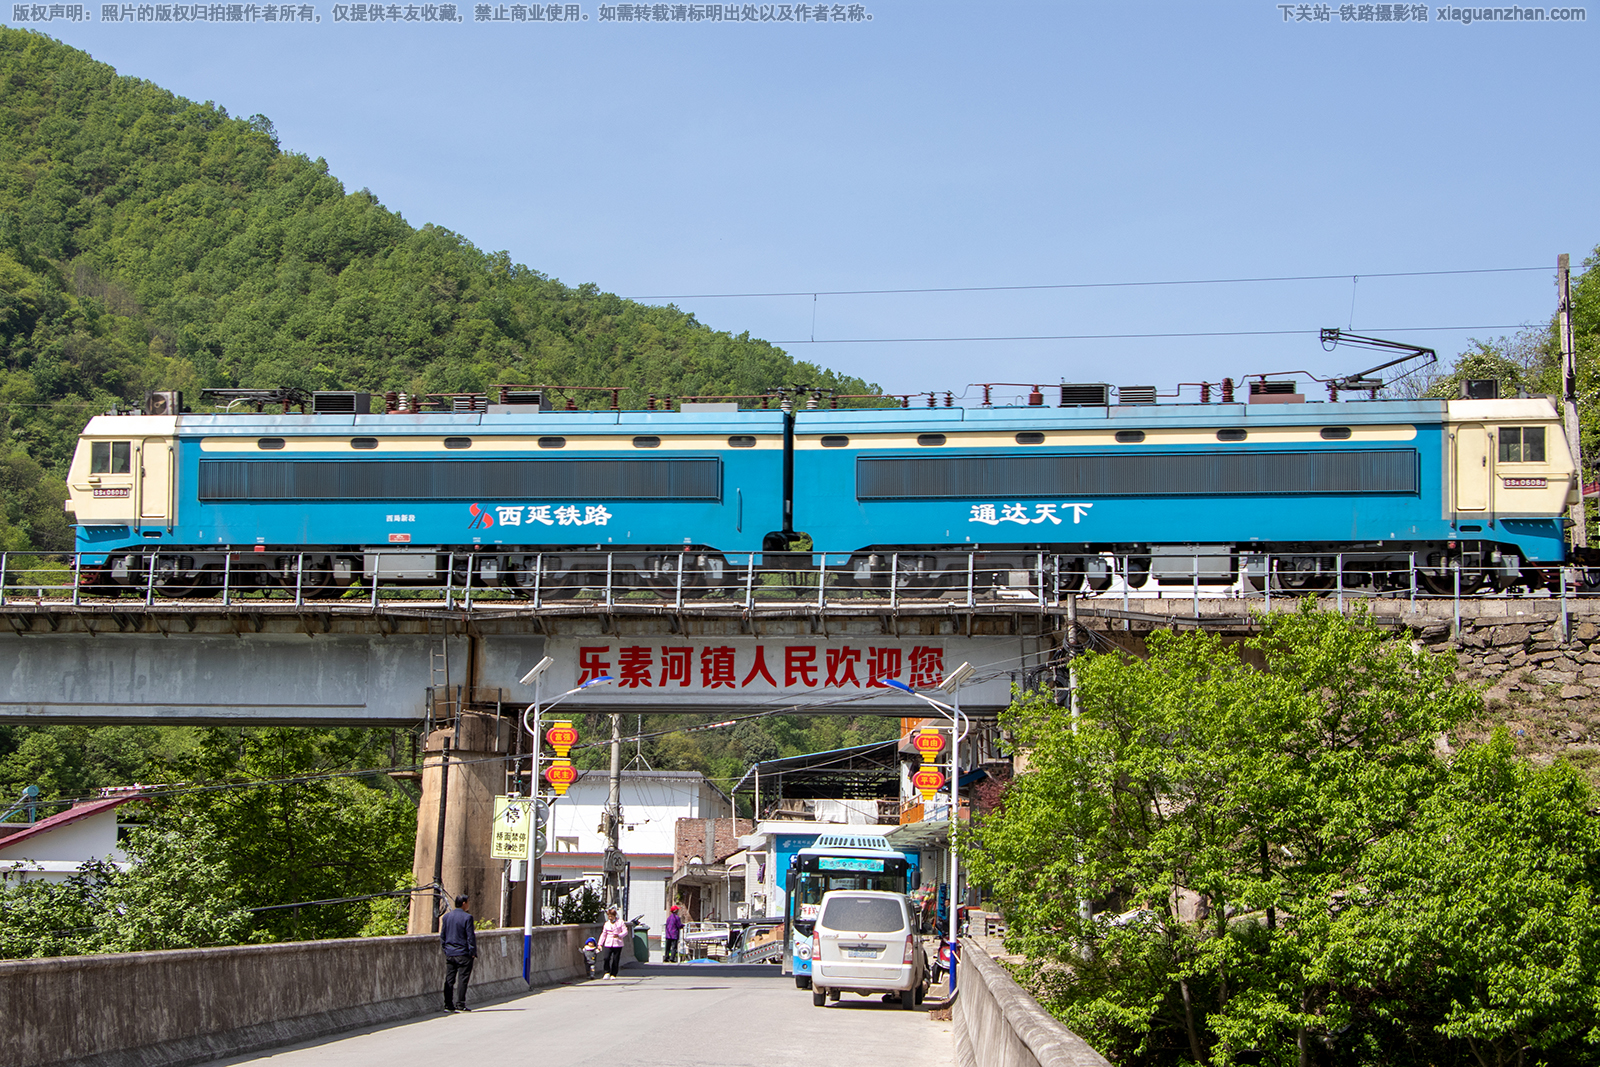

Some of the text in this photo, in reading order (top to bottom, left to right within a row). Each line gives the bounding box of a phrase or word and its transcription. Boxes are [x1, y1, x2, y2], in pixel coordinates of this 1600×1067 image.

[495, 504, 612, 527] 西延铁路
[968, 502, 1094, 526] 通达天下
[577, 645, 944, 690] 乐素河镇人民欢迎您
[555, 733, 571, 741] 富强
[922, 739, 938, 747] 自由
[553, 771, 569, 779] 民主
[921, 776, 937, 785] 平等
[506, 807, 520, 823] 停
